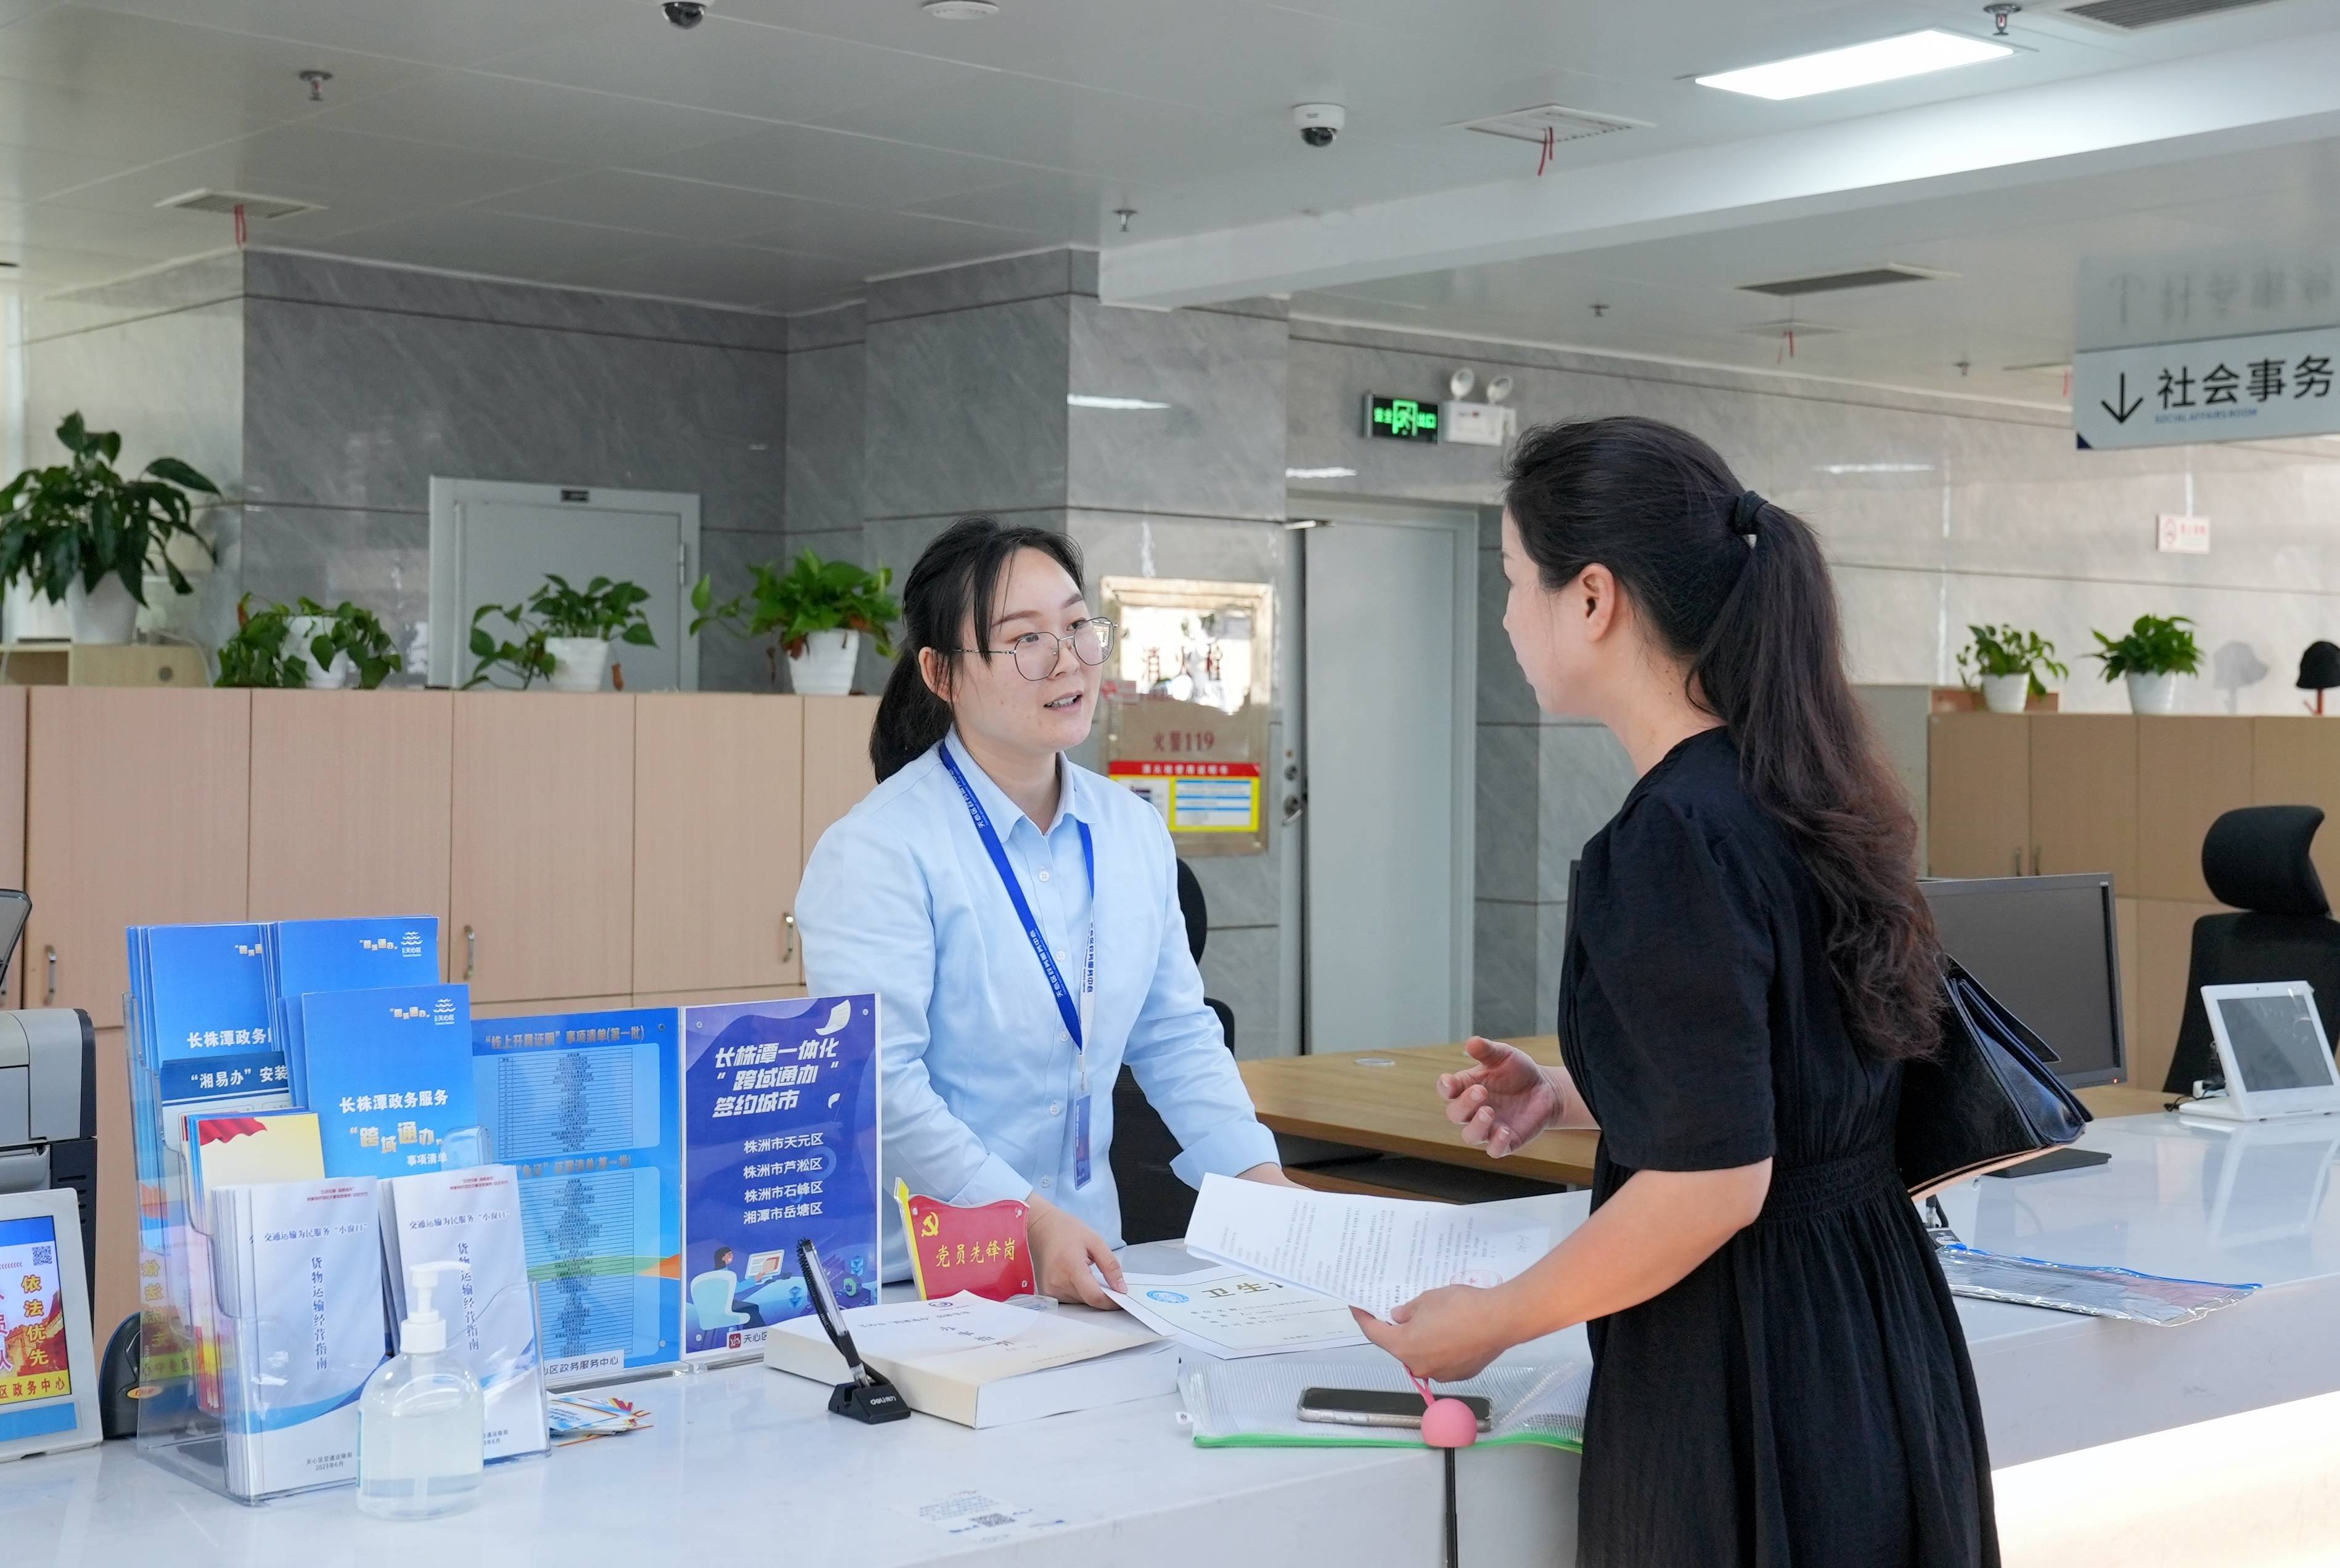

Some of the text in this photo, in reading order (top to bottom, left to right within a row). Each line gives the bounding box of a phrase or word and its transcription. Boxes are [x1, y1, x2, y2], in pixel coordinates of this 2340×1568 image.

[2156, 355, 2334, 410] 社会事务
[187, 1027, 272, 1049] 长株潭政务
[715, 1037, 840, 1068] 长株潭一体化
[190, 1065, 288, 1089] “湘易办” 安装
[339, 1089, 448, 1114] 长株潭政务服务
[713, 1089, 800, 1118] 签约城市
[743, 1132, 824, 1154] 株洲市天元区
[407, 1151, 448, 1167] 事项清单
[743, 1157, 823, 1179] 株洲市芦淞区
[744, 1180, 824, 1203] 株洲市石峰区
[743, 1202, 824, 1225] 湘潭市岳塘区
[935, 1237, 1016, 1268] 党员先锋岗
[1201, 1282, 1285, 1299] 卫生
[21, 1275, 49, 1366] 依法优先
[311, 1256, 327, 1370] 货物运输经营指南
[0, 1376, 65, 1399] 区政务中心
